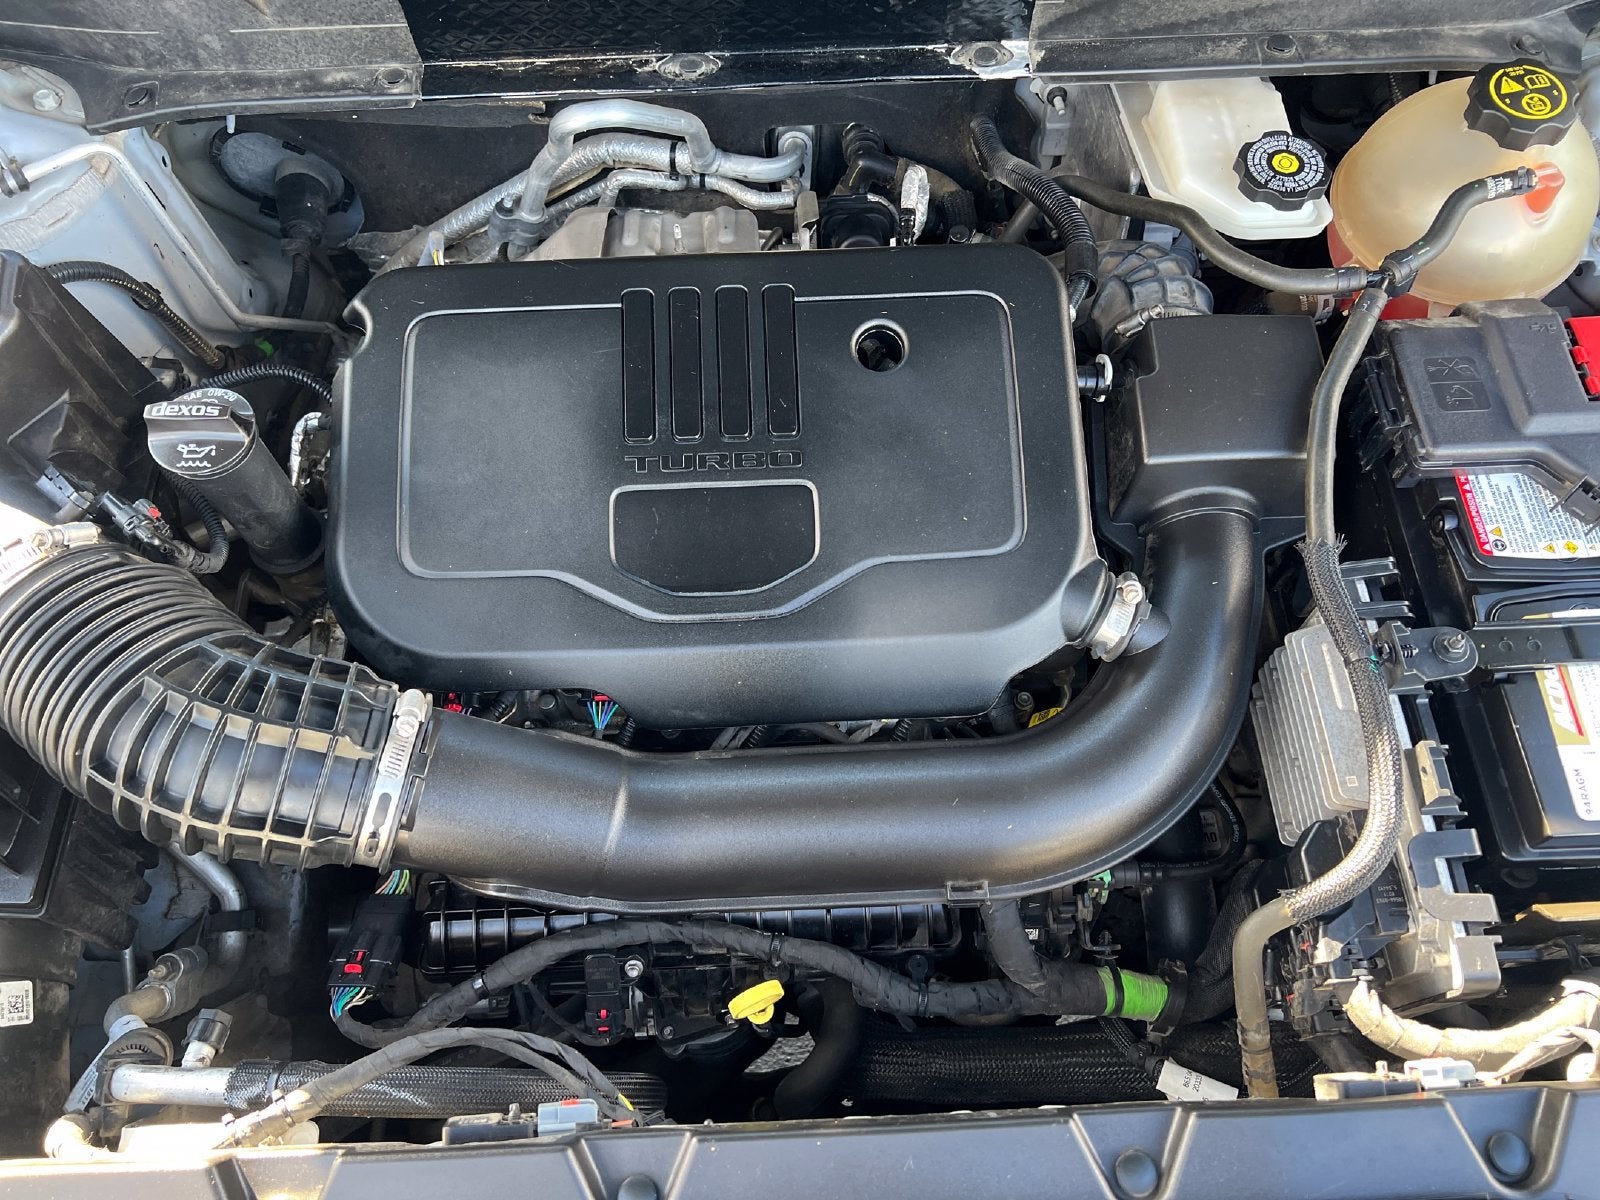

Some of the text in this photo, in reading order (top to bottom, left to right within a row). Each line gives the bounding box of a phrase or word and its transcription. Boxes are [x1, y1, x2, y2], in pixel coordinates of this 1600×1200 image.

[183, 389, 237, 402] SAE 0W-20
[151, 402, 221, 416] dexos
[624, 450, 803, 474] TURBO
[1465, 492, 1489, 543] DANGER/POISON
[1574, 768, 1593, 815] 94RAGM
